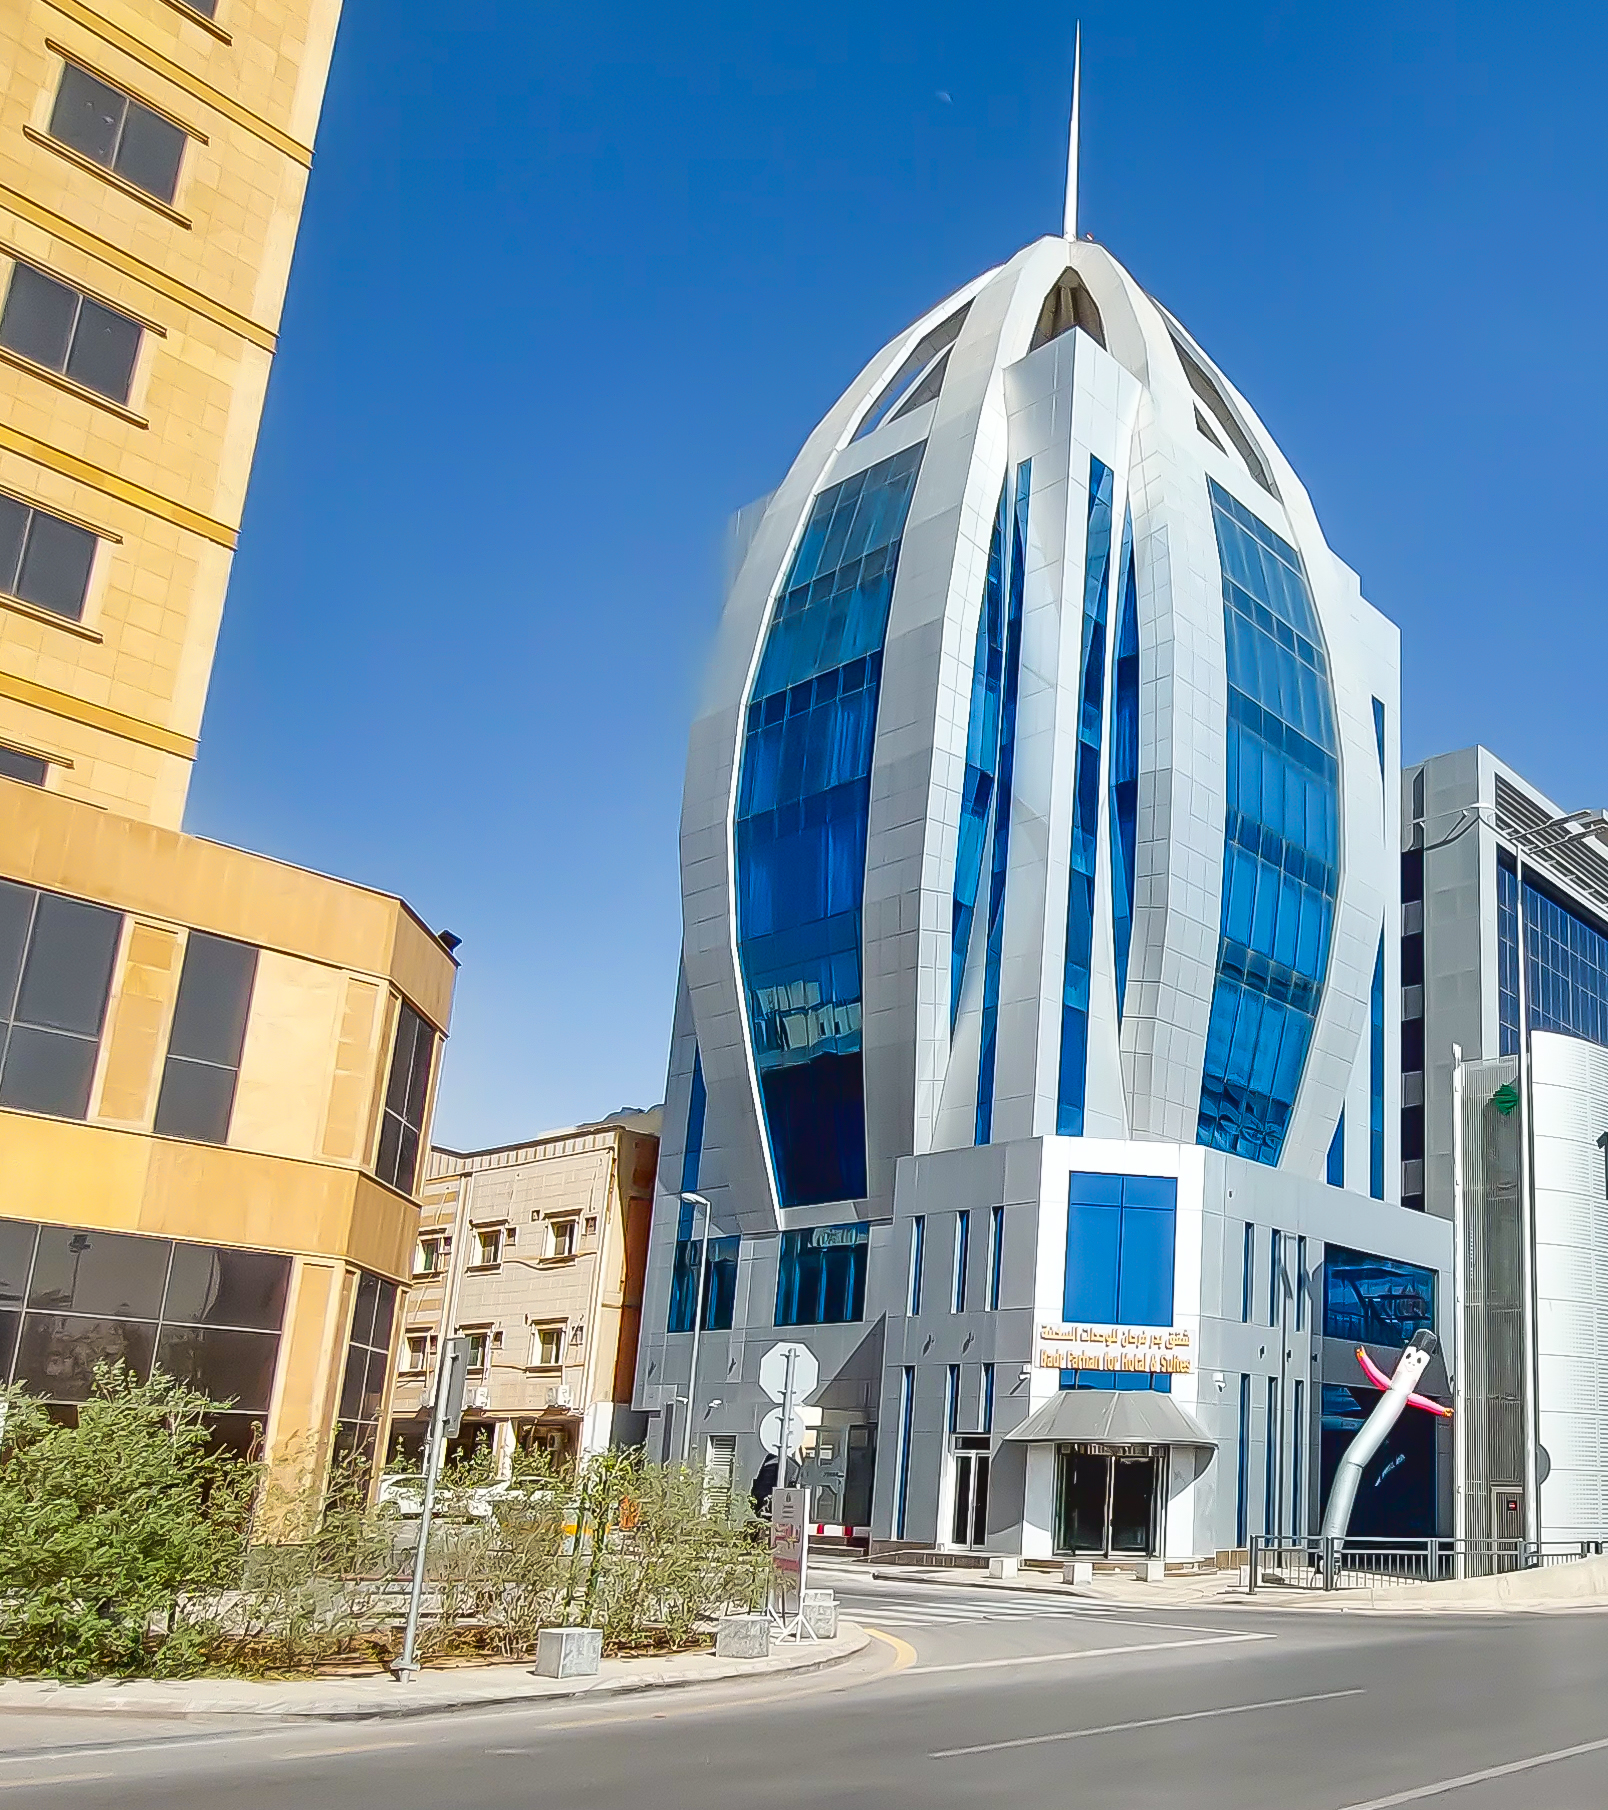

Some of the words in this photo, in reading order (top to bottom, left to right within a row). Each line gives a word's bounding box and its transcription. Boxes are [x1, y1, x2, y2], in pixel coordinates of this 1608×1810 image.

[1080, 1326, 1119, 1347] للوحدات
[1103, 1352, 1119, 1371] for
[1149, 1354, 1158, 1373] &
